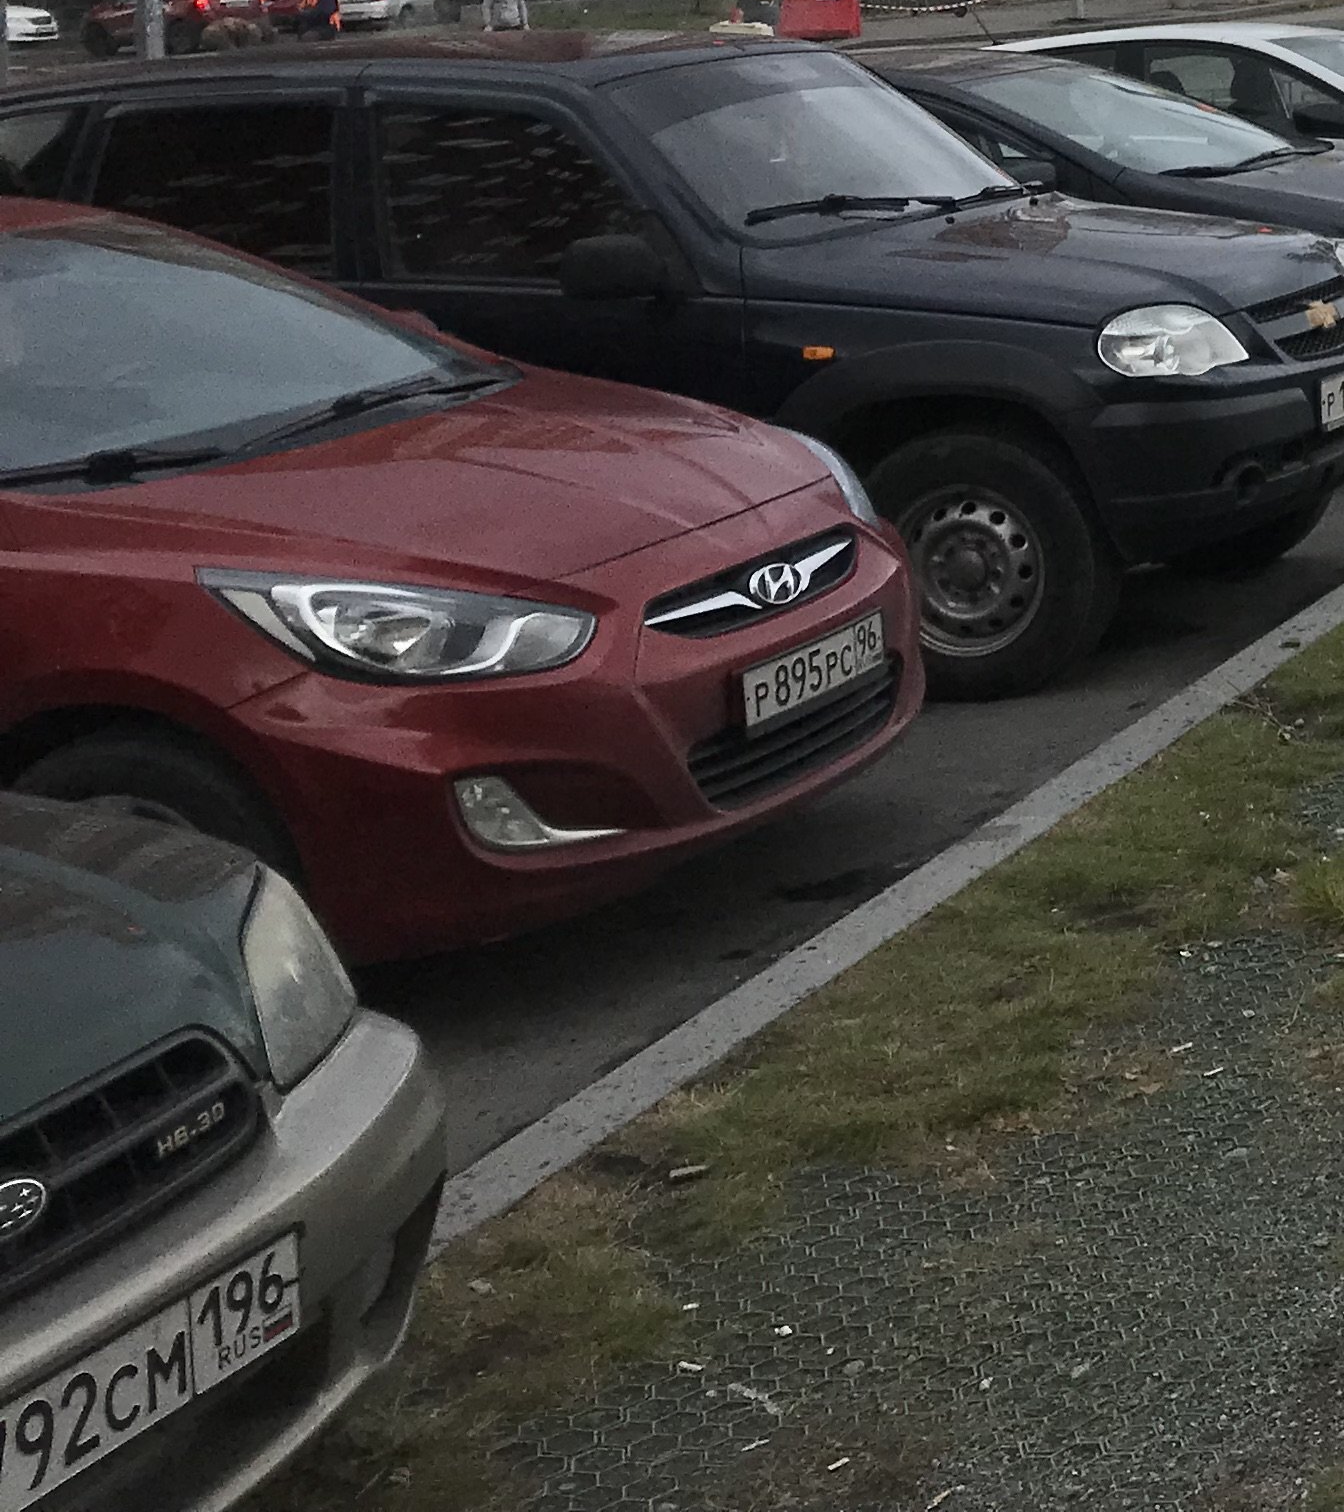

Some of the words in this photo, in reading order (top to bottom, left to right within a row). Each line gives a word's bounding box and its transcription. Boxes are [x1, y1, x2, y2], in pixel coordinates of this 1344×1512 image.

[857, 620, 878, 658] 96
[0, 1330, 189, 1491] 92СМ
[197, 1251, 286, 1348] 196
[216, 1329, 263, 1371] RUS
